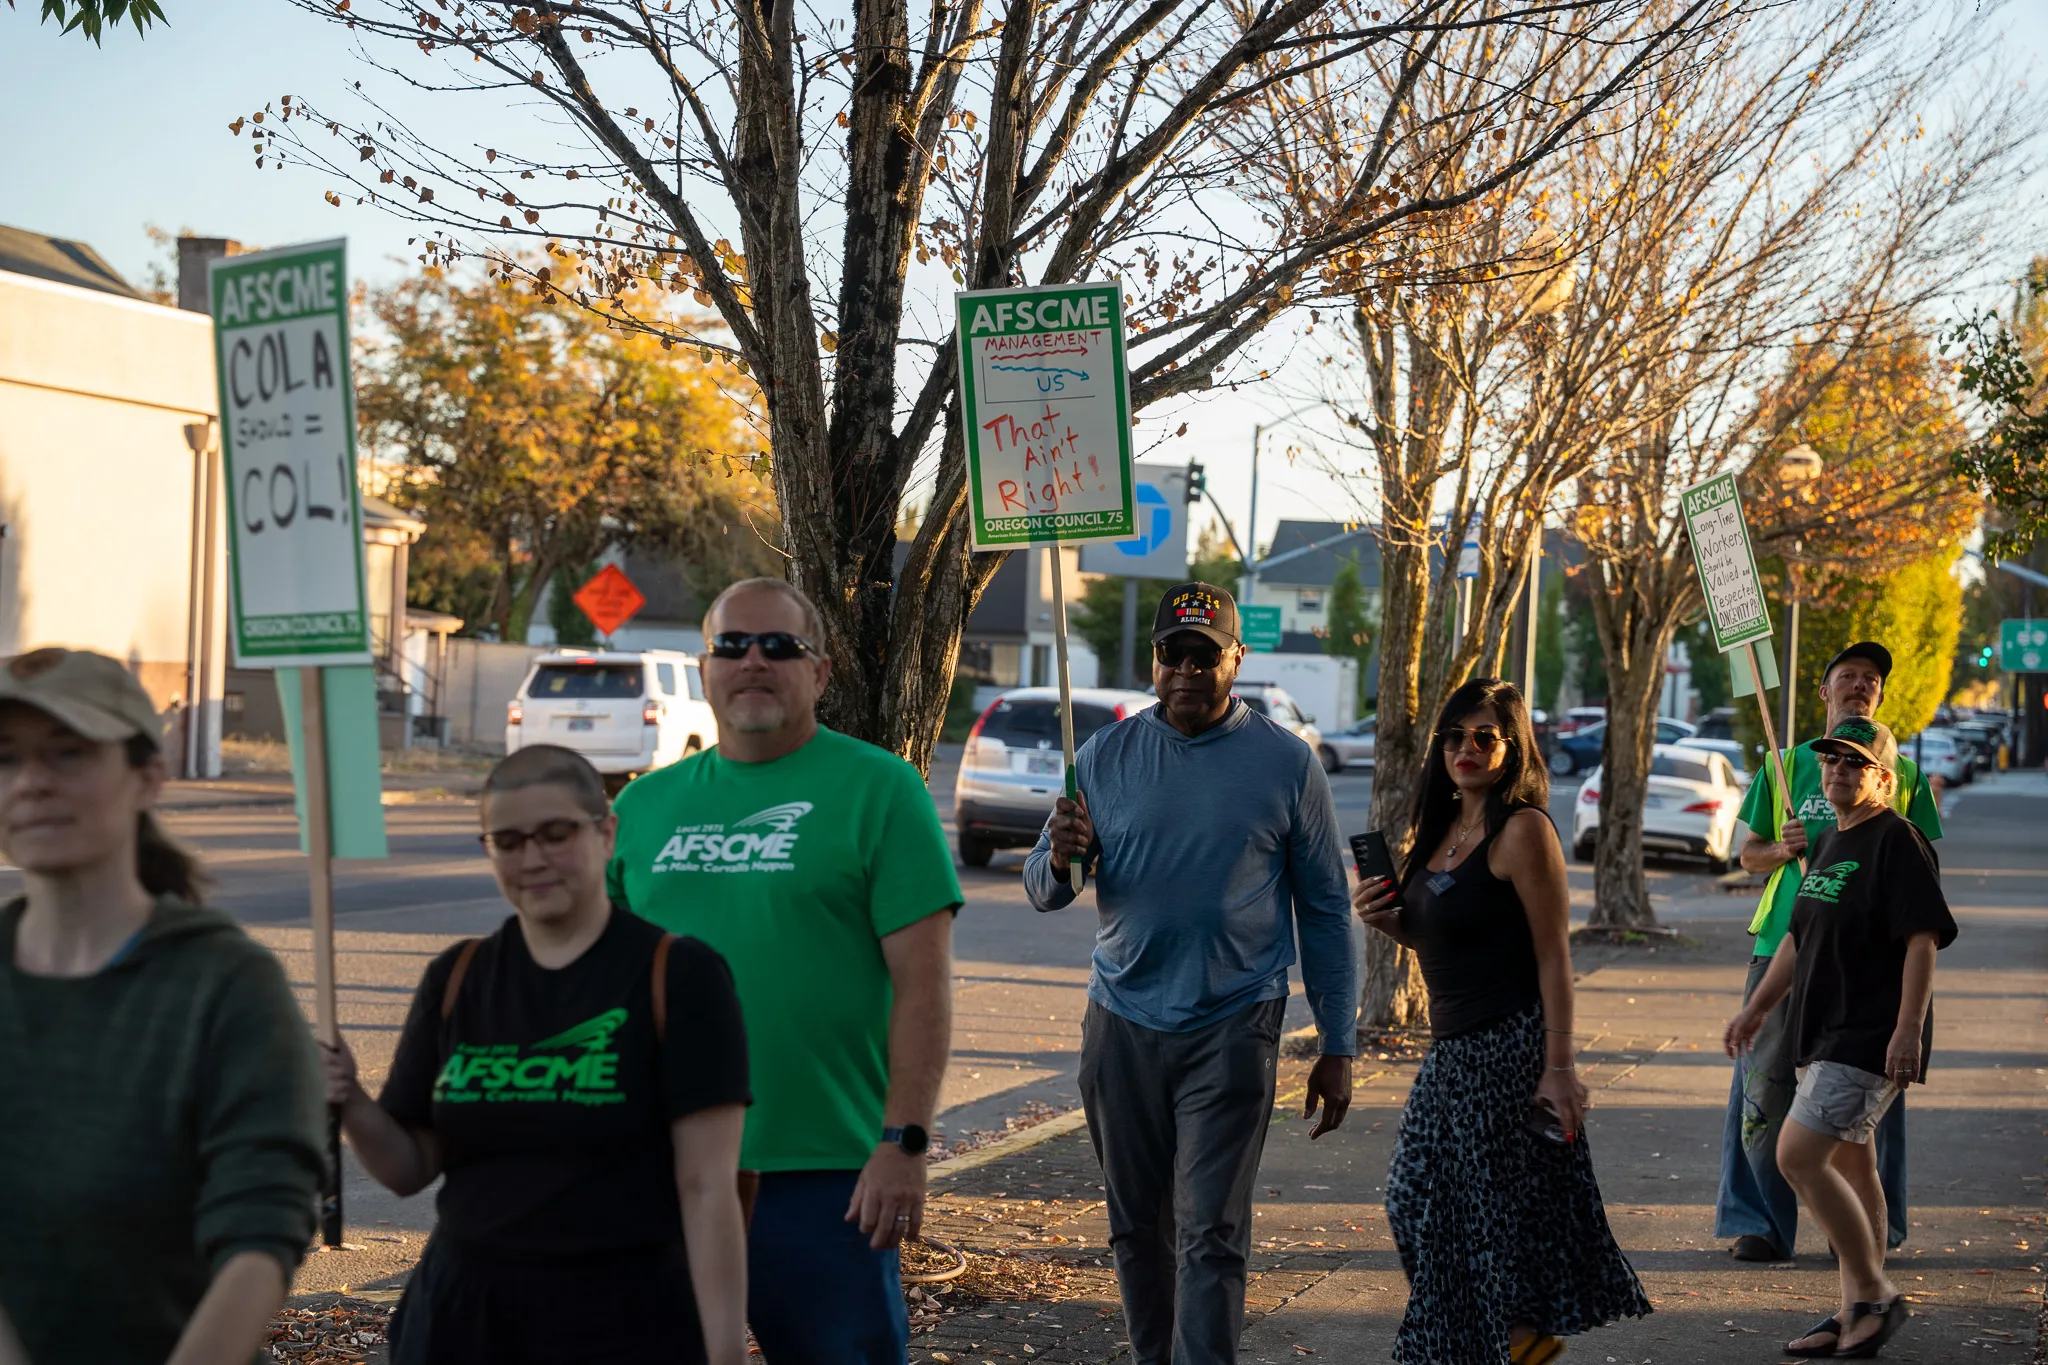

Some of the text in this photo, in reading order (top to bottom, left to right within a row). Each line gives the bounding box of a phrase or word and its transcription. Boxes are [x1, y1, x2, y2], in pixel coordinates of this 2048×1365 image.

[221, 261, 337, 326] AFSCME
[970, 296, 1110, 334] AFSCME
[984, 331, 1102, 351] MANAGEMENT
[230, 328, 335, 410] COLA
[1036, 374, 1065, 392] US
[983, 404, 1060, 452] That
[1025, 426, 1079, 472] Ain't
[242, 452, 349, 535] COL!
[1688, 479, 1733, 515] AFSCME
[984, 511, 1124, 532] OREGON COUNCIL 75
[1051, 528, 1067, 536] County
[1077, 526, 1098, 534] Municipal
[1099, 525, 1122, 533] Employees
[1697, 531, 1743, 560] Workers
[1725, 554, 1733, 566] be
[1706, 565, 1750, 591] Valued and
[1172, 591, 1220, 609] DD-214
[1180, 616, 1211, 625] ALUMNI
[1716, 601, 1750, 630] LONGEVITY
[1798, 799, 1835, 814] AFS
[654, 832, 799, 863] AFSCME
[435, 1052, 619, 1089] AFSCME
